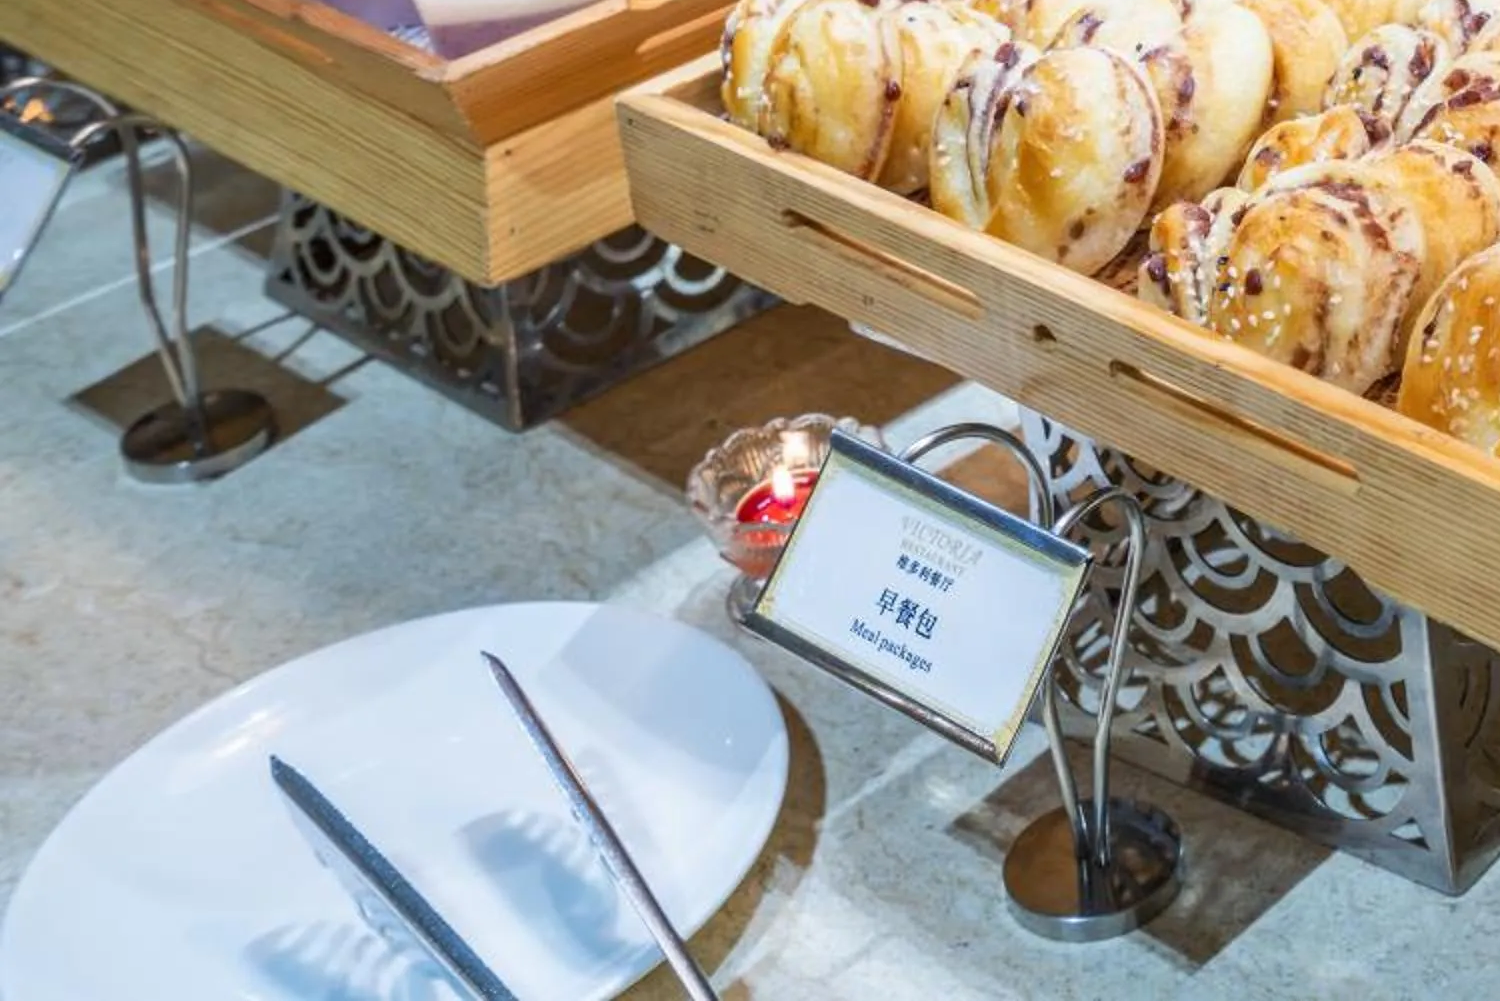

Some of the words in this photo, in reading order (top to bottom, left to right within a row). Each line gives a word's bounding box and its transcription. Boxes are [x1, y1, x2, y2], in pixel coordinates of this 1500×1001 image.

[899, 515, 984, 566] VICTORIA
[874, 587, 941, 640] 早餐包
[849, 618, 883, 645] Meal
[877, 637, 934, 675] packages
